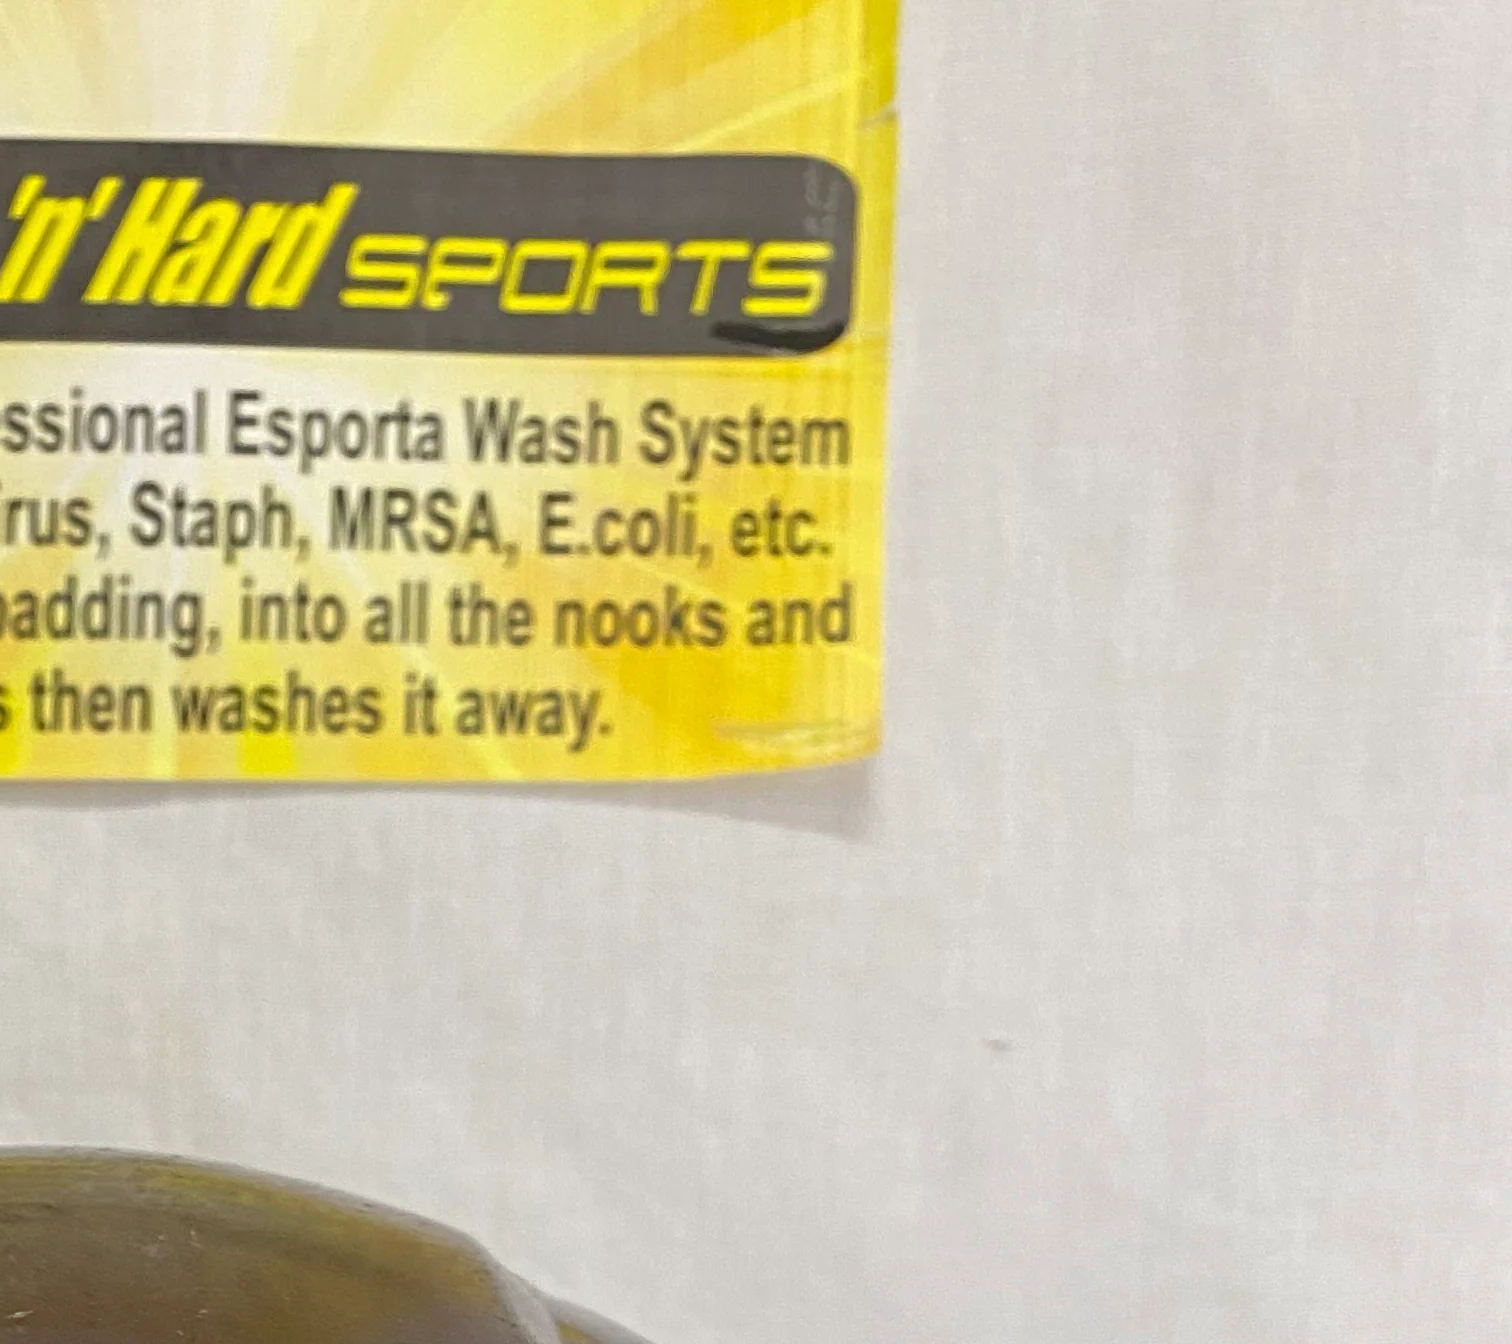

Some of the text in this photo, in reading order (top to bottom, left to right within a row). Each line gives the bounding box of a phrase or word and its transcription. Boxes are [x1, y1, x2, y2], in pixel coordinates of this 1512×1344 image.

[82, 174, 361, 312] Hard
[339, 232, 835, 318] SPORTS
[227, 391, 445, 473] Esporta
[463, 397, 619, 465] Wash
[639, 399, 851, 481] System
[131, 479, 310, 562] Staph,
[329, 488, 520, 567] MRSA,
[538, 490, 713, 567] E.coli,
[730, 496, 834, 557] etc.
[241, 578, 347, 643] into
[365, 580, 430, 646] all
[449, 583, 535, 647] the
[554, 584, 727, 648] nooks
[745, 583, 854, 647] and
[30, 669, 152, 733] then
[170, 669, 382, 736] washes
[403, 672, 438, 736] it
[456, 684, 613, 754] away.
